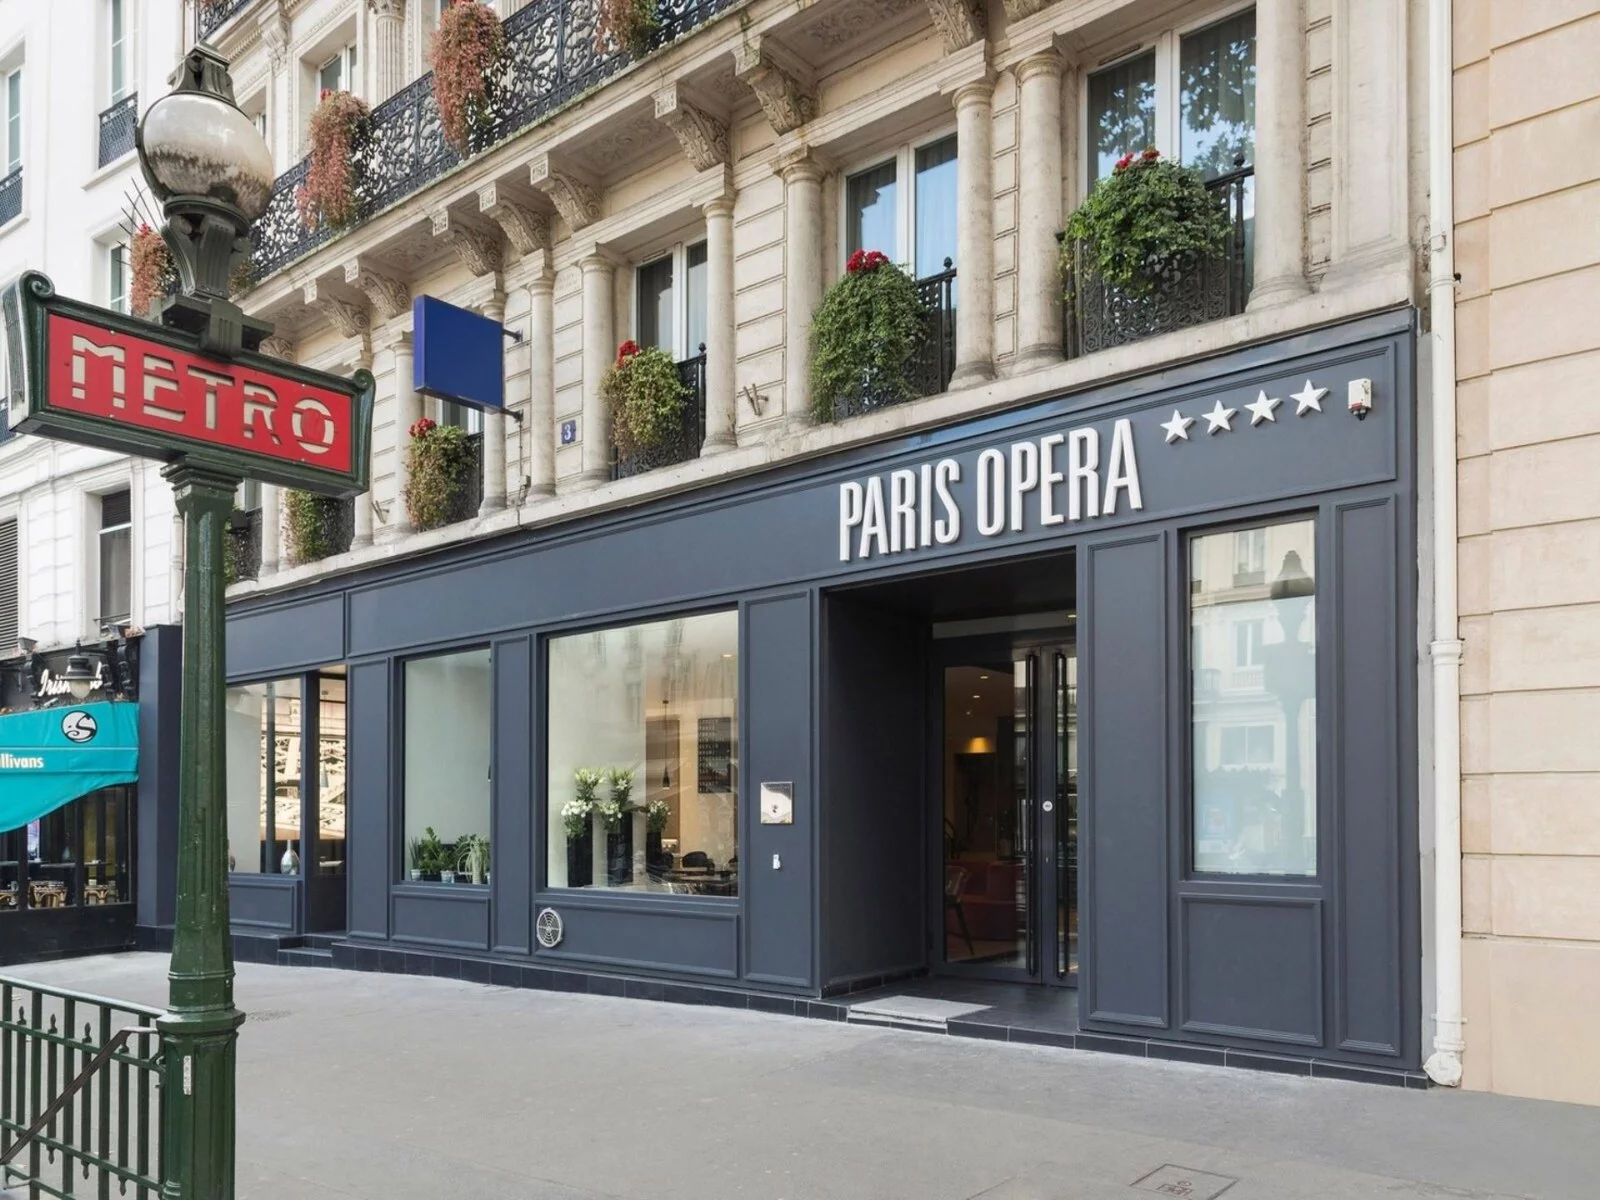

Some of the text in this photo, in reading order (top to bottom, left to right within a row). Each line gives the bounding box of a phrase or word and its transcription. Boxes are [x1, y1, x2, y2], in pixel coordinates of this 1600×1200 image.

[71, 334, 336, 455] METRO
[564, 424, 572, 441] 3
[839, 418, 1145, 562] PARIS OPERA
[0, 753, 44, 769] llivans
